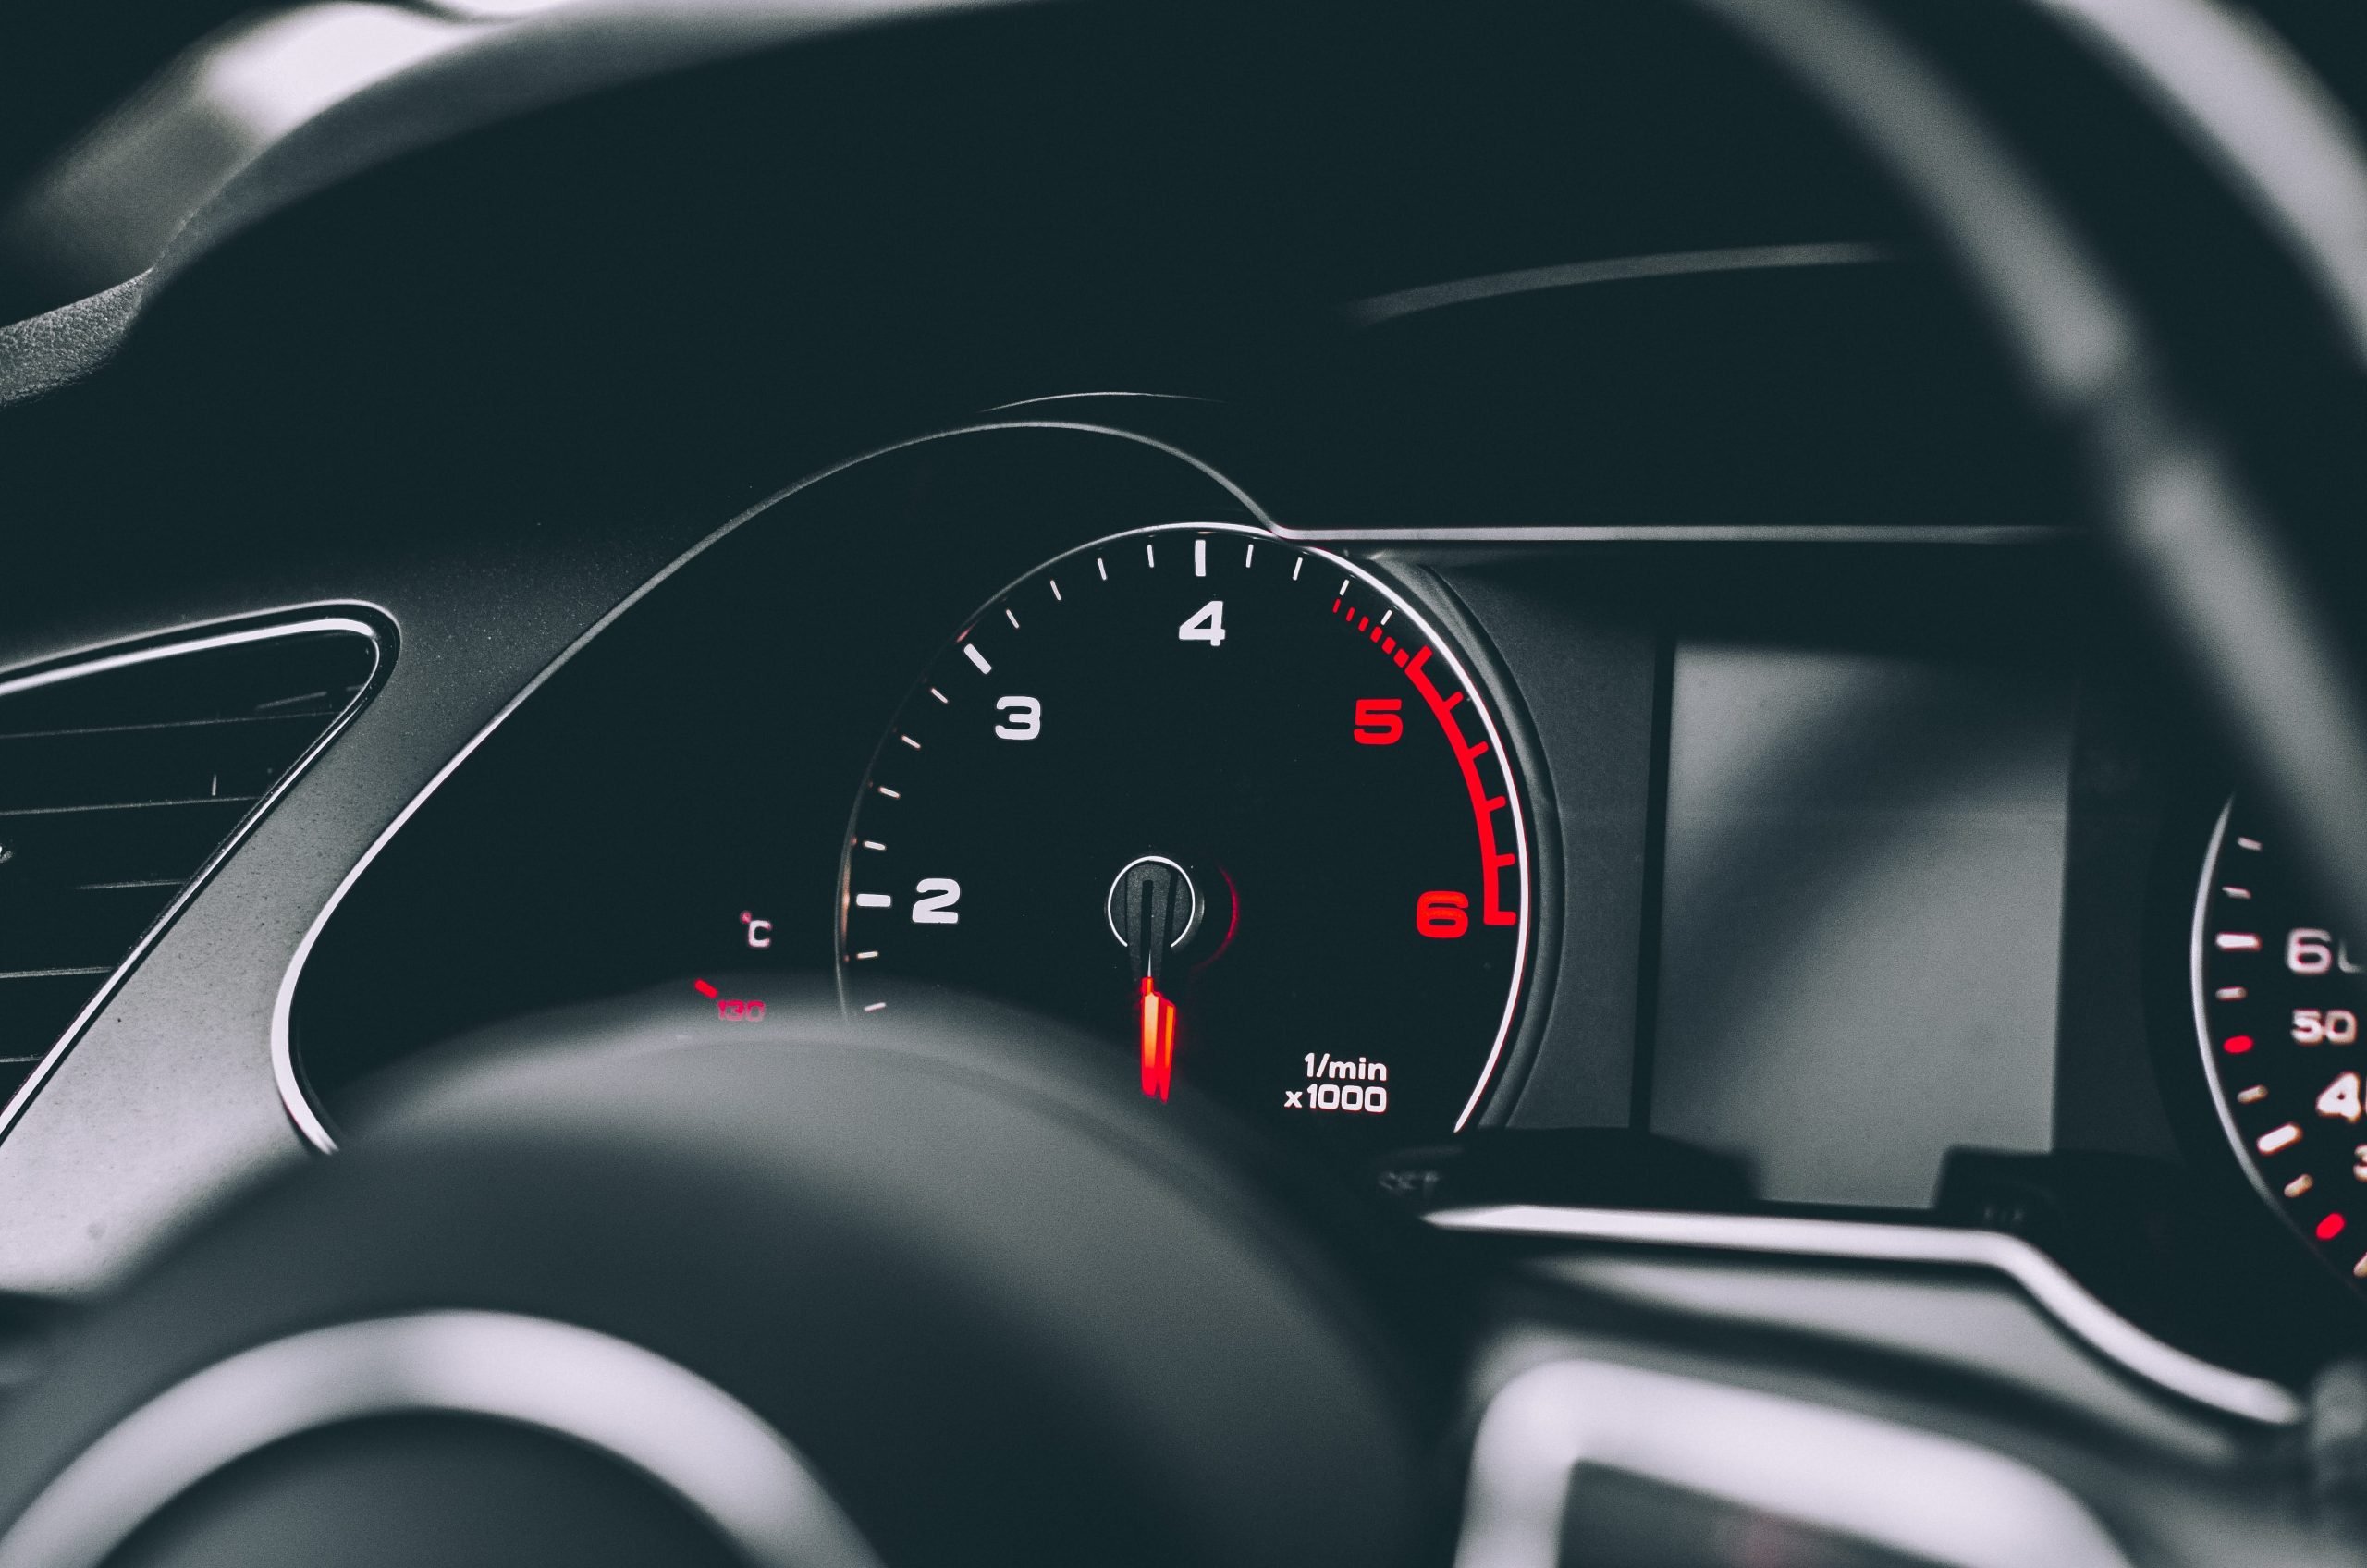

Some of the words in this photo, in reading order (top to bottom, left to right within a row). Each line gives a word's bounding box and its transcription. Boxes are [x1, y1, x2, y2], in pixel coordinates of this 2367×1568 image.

[1178, 600, 1226, 647] 4
[994, 695, 1042, 741] 3
[1353, 698, 1404, 746] 5
[911, 877, 961, 925] 2
[1415, 889, 1470, 939] 6
[717, 998, 767, 1022] 130
[2291, 1008, 2358, 1045] 50
[1304, 1052, 1388, 1082] 1/min
[1283, 1083, 1388, 1114] x1000
[2315, 1071, 2367, 1123] 4
